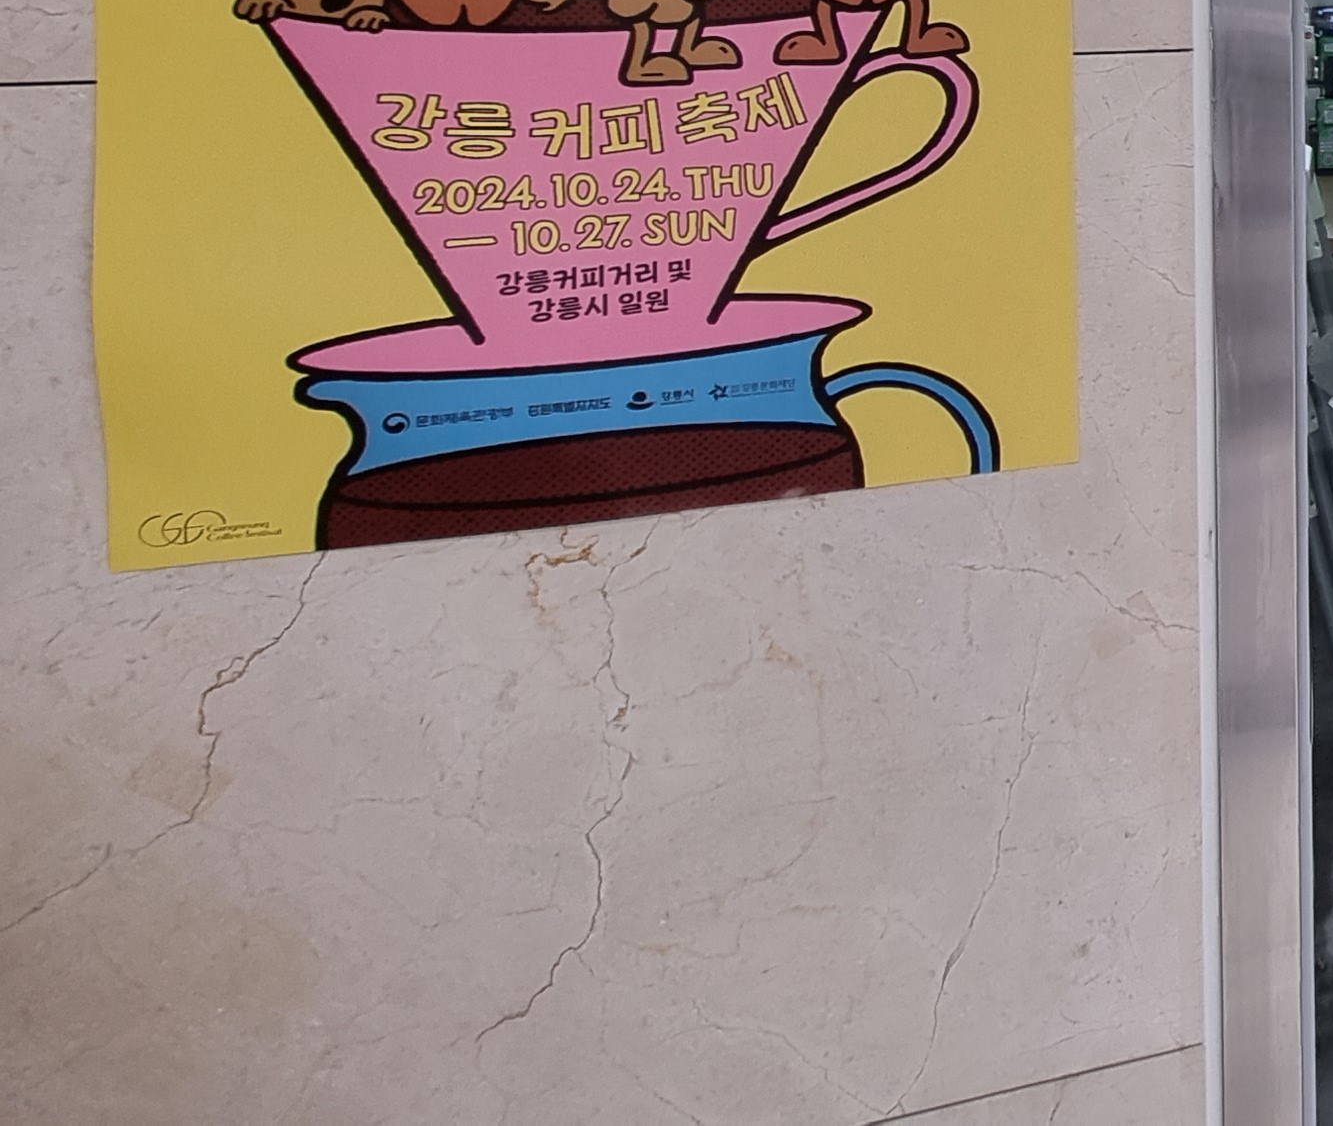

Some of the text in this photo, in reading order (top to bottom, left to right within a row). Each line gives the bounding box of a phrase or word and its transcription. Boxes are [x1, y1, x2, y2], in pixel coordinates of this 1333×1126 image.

[371, 71, 808, 160] 강릉 커피 축제
[641, 207, 736, 245] SUN
[496, 258, 693, 297] 강릉커피거리 및
[528, 289, 670, 323] 강릉시 일원
